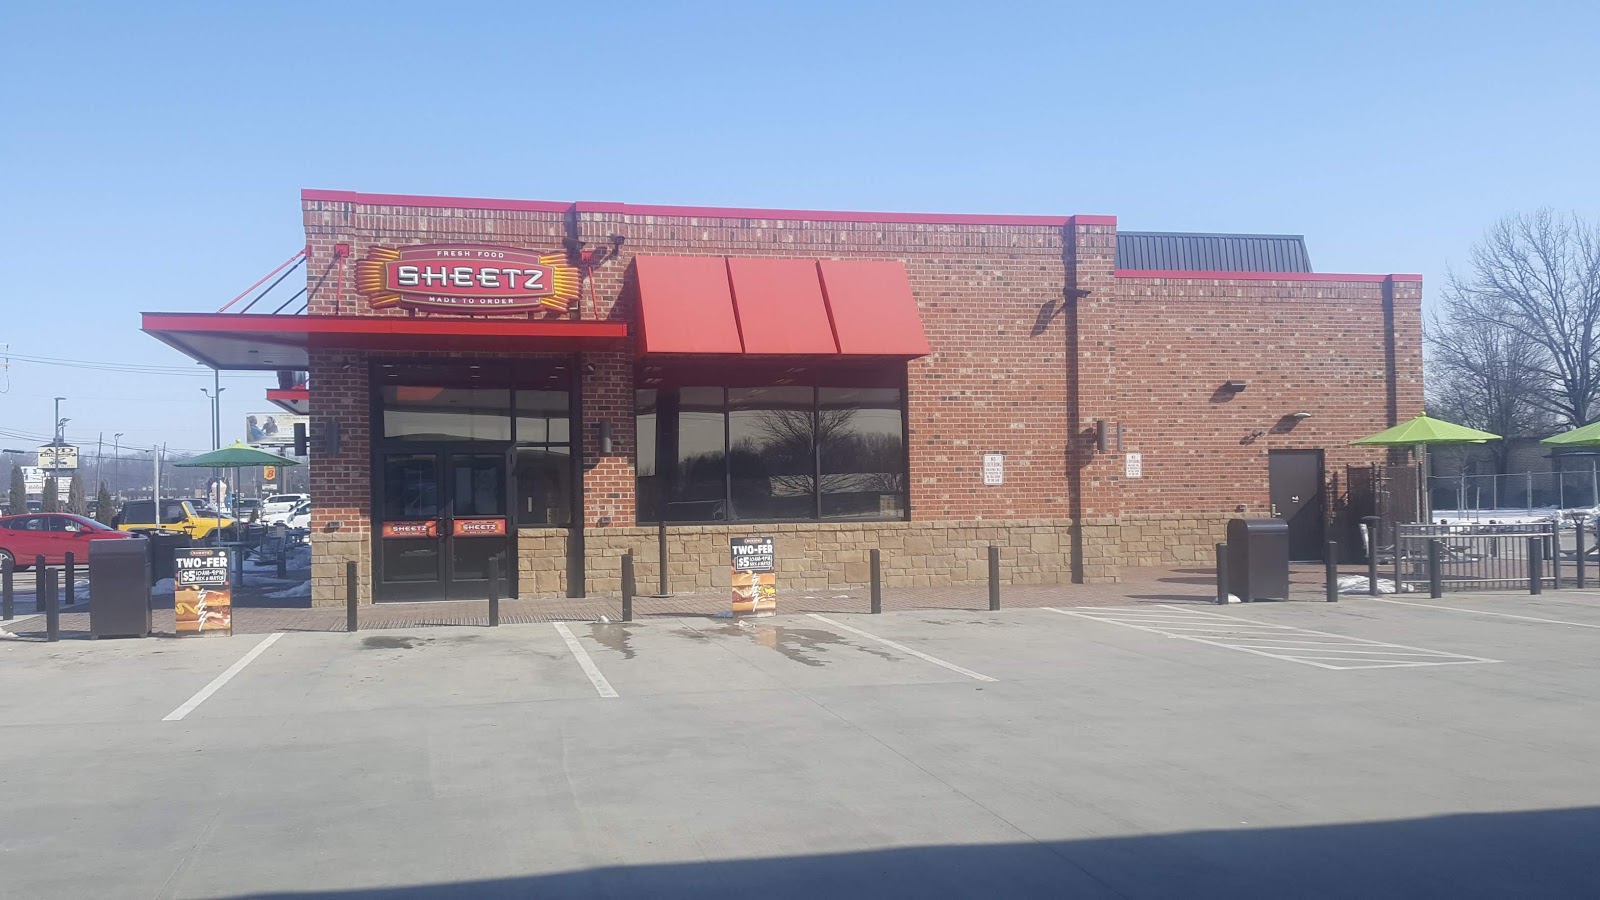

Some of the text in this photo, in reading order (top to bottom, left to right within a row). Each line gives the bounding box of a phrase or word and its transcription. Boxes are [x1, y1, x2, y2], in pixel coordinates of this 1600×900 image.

[398, 265, 544, 290] SHEETZ
[428, 296, 457, 304] MADE
[732, 545, 773, 555] TWO-FER
[176, 557, 228, 568] TWO-FER
[738, 556, 750, 567] $5
[183, 570, 196, 581] $5
